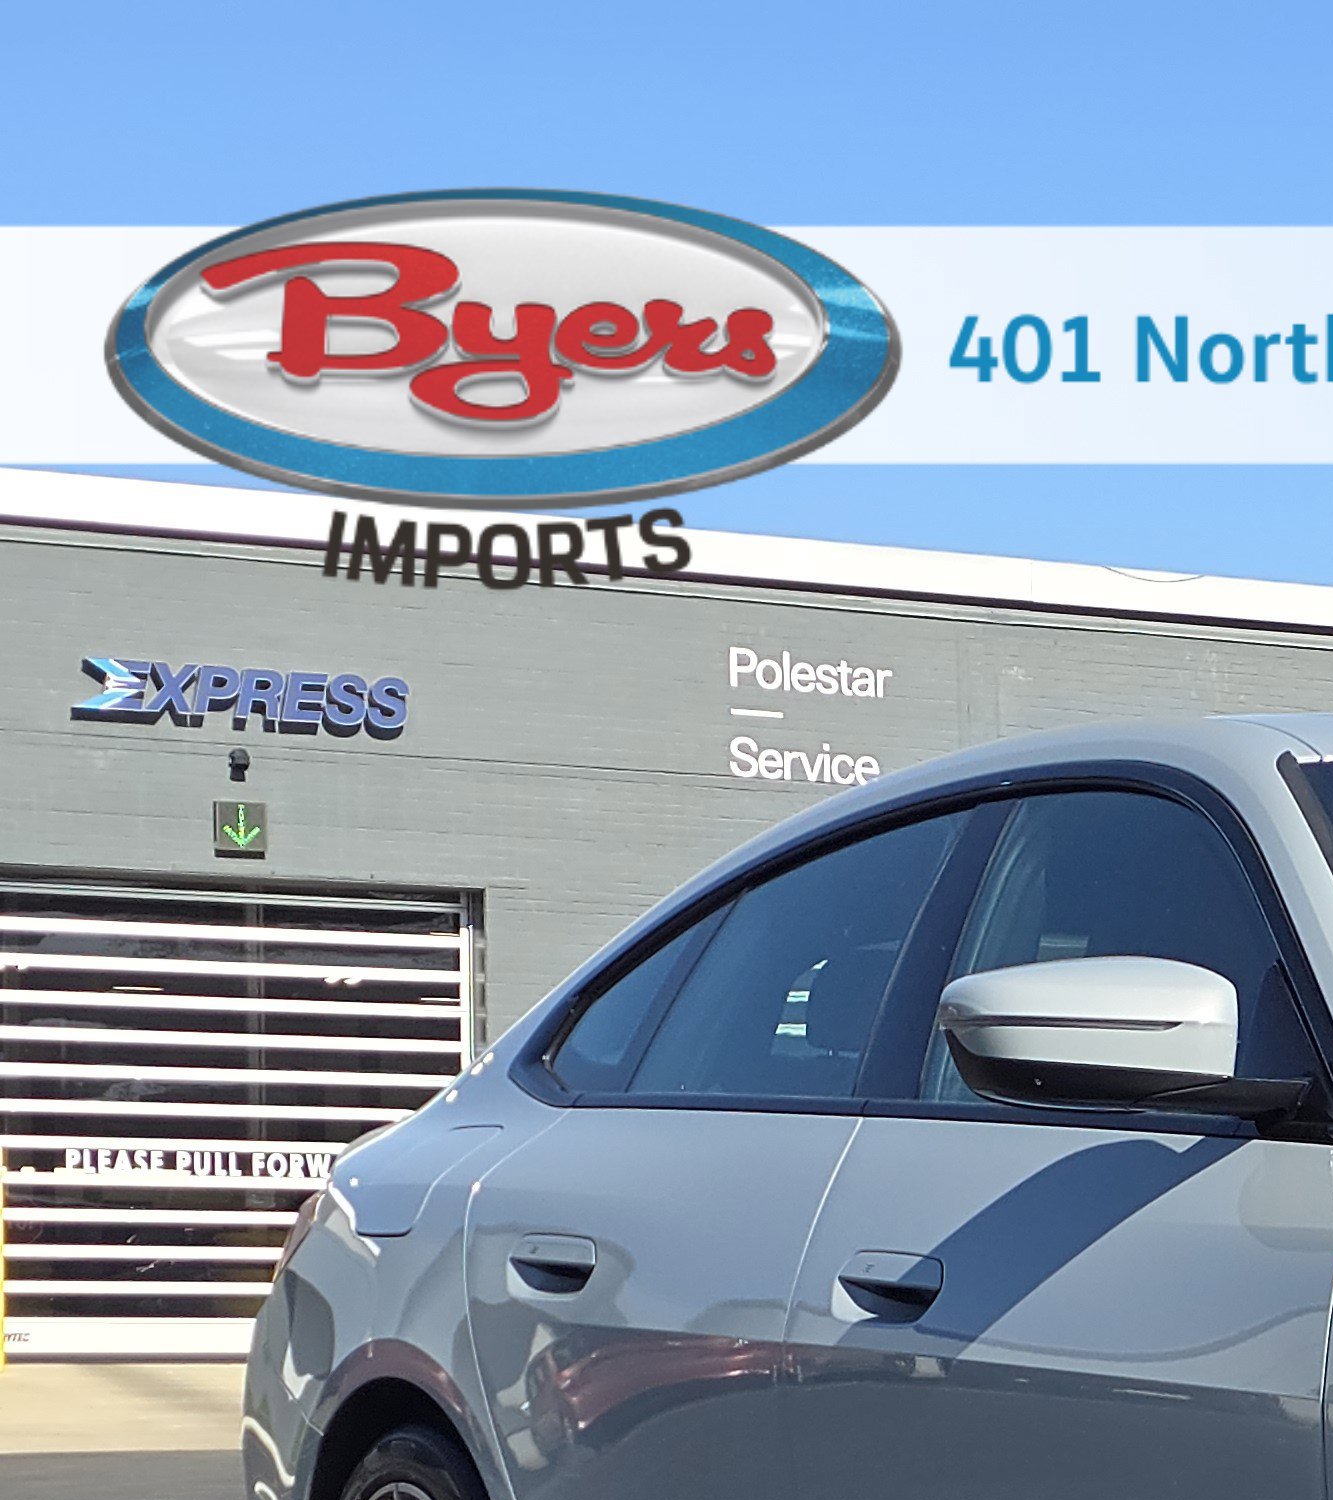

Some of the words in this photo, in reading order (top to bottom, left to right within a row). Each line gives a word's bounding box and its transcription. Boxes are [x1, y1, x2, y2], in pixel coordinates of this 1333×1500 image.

[70, 657, 410, 735] EXPRESS
[729, 646, 893, 698] Polestar
[729, 736, 880, 786] Service
[65, 1148, 164, 1174] PLEASE
[175, 1150, 243, 1177] PULL
[252, 1152, 333, 1178] FORW
